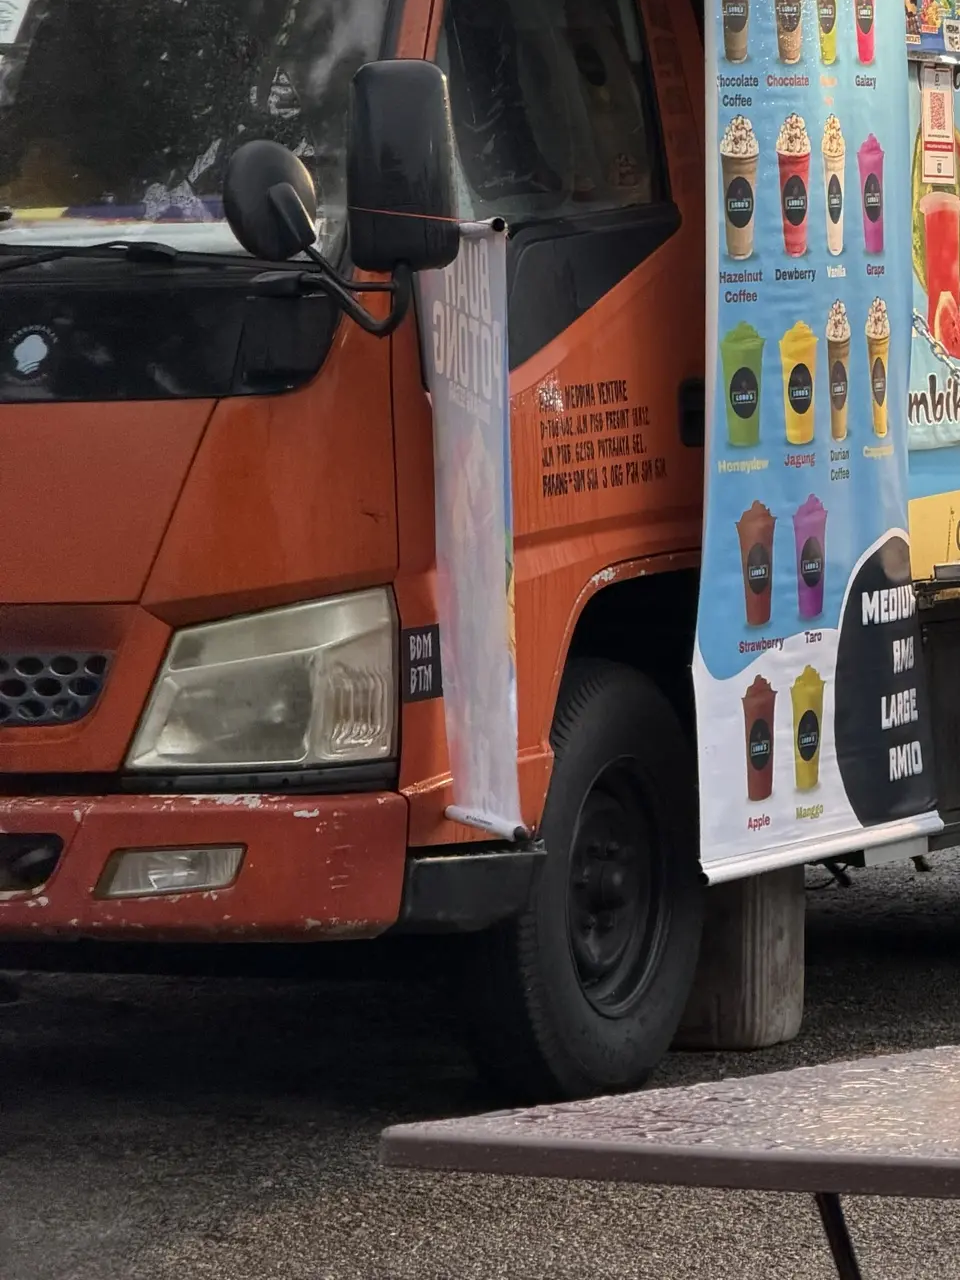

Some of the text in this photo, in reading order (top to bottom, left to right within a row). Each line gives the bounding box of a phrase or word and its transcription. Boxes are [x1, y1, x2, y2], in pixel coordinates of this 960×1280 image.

[717, 74, 759, 87] hocolate
[766, 74, 809, 87] Chocolate
[855, 74, 877, 90] Galaxy
[722, 94, 752, 107] Coffee
[719, 270, 763, 284] Hazelnut
[775, 268, 816, 282] Dewberry
[826, 265, 847, 278] Vanilla
[866, 264, 885, 278] Grape
[724, 290, 758, 303] Coffee
[784, 453, 816, 468] Jagung
[830, 448, 850, 462] Durian
[718, 458, 769, 474] Honeydew
[830, 467, 850, 481] Coffee
[804, 630, 822, 644] Taro
[409, 632, 432, 661] BDM
[738, 636, 784, 654] Strawberry
[410, 664, 432, 694] BTM
[880, 687, 919, 731] LARGE
[889, 740, 923, 782] RM10
[796, 804, 823, 819] Manggo
[747, 814, 770, 831] Apple
